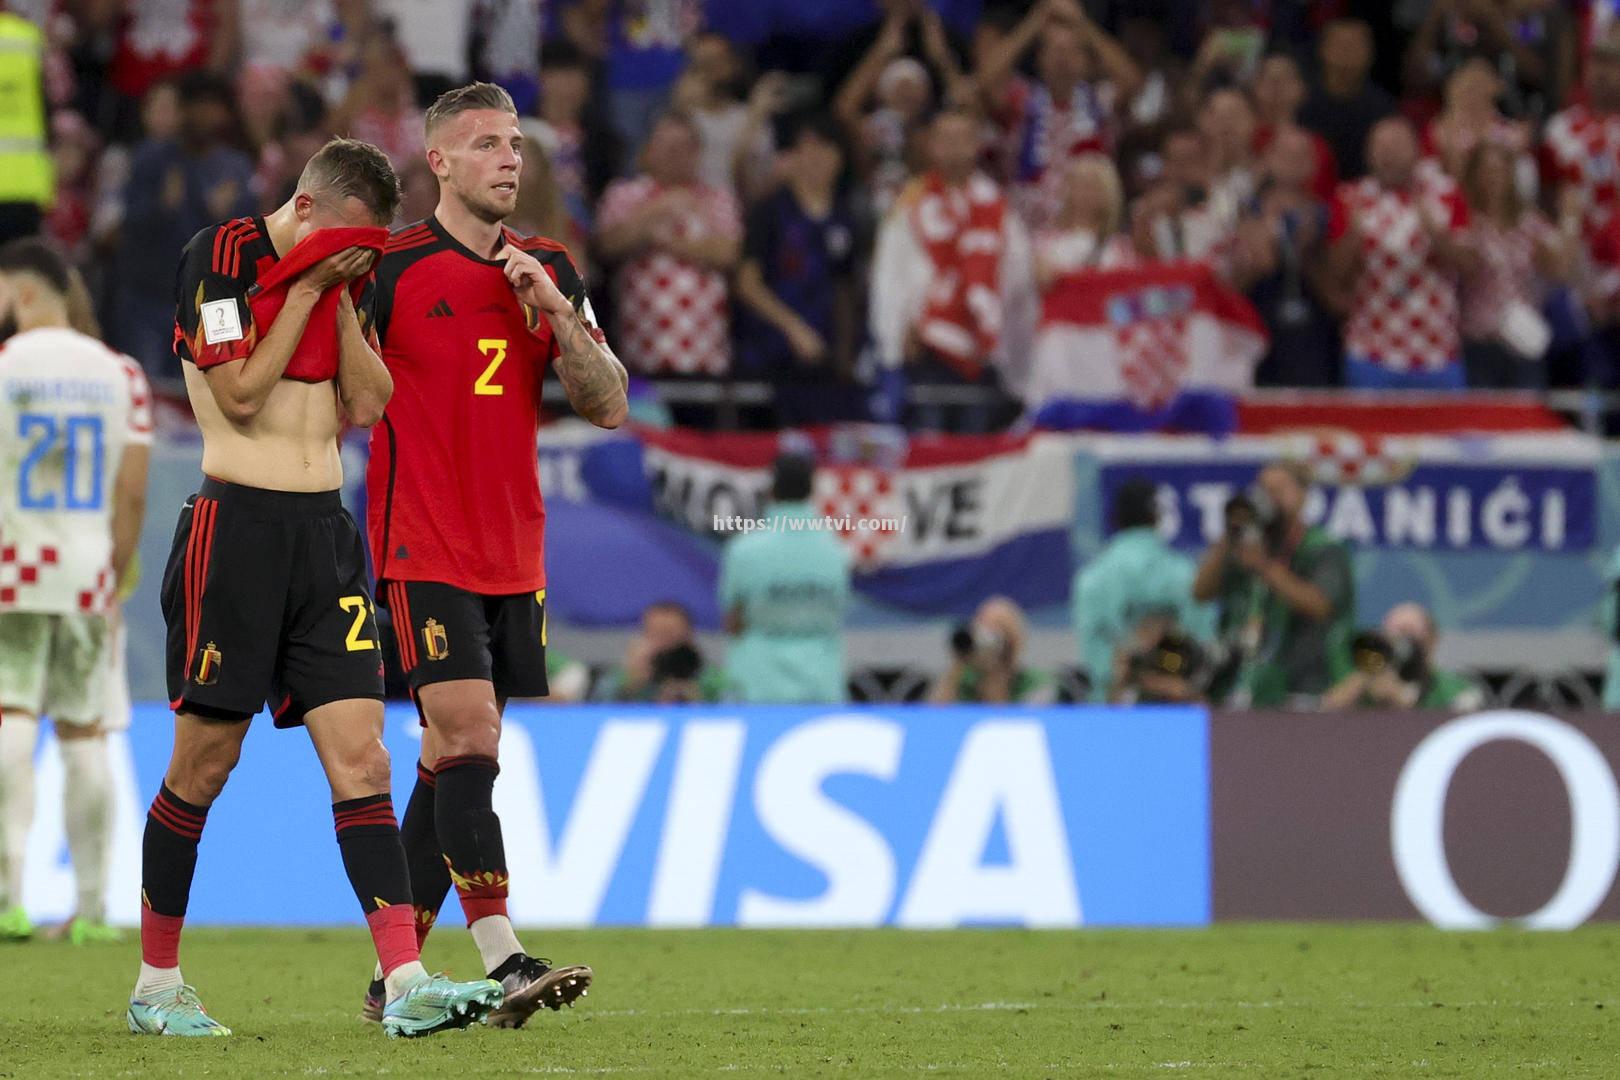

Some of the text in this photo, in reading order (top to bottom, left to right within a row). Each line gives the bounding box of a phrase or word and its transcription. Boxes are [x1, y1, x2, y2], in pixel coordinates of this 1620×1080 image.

[474, 339, 508, 395] 2
[18, 414, 104, 510] 20
[405, 713, 1084, 927] VISA
[1389, 709, 1620, 931] O
